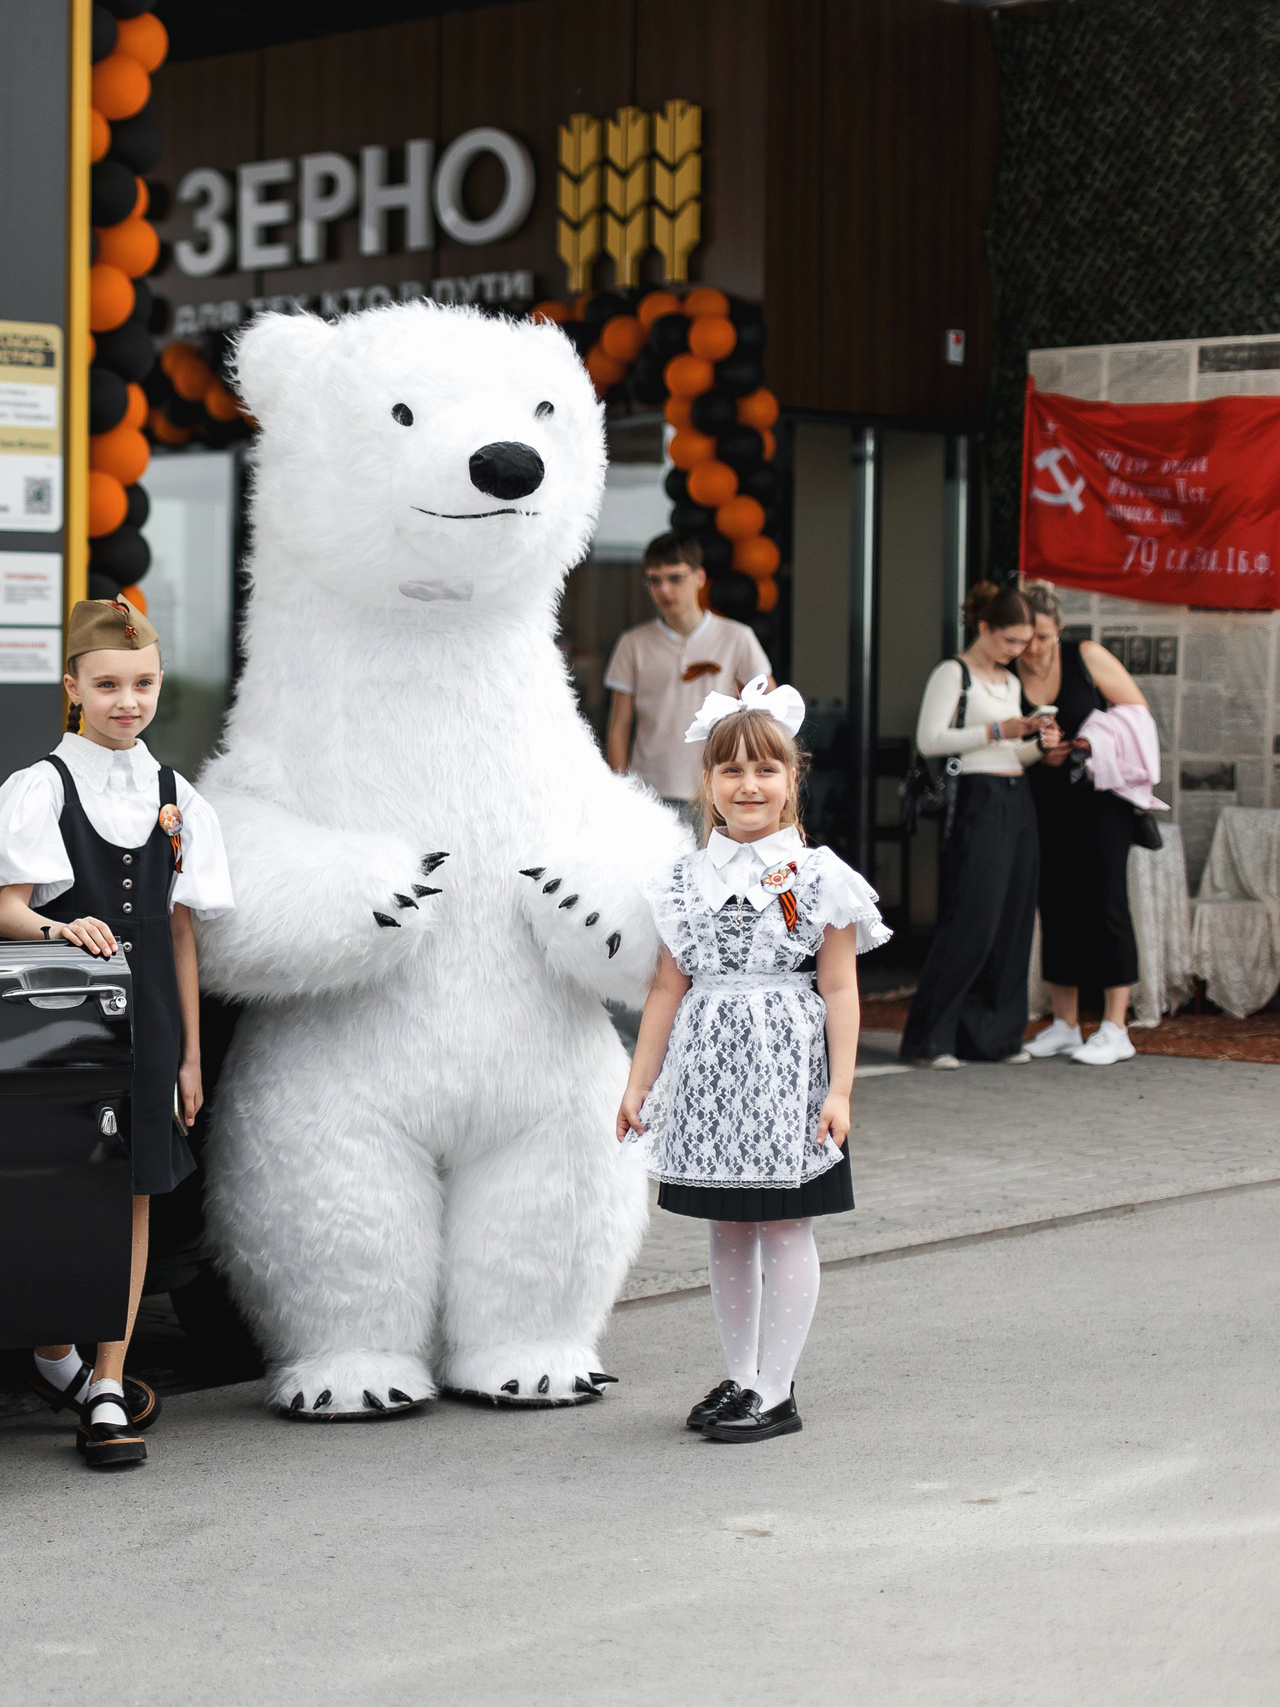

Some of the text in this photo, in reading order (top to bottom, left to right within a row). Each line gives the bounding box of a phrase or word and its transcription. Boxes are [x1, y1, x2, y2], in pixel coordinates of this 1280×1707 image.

[173, 126, 536, 279] ЗЕРНО
[172, 301, 241, 338] ДЛЯ
[431, 270, 534, 305] ПУТИ
[1123, 534, 1159, 576] 79
